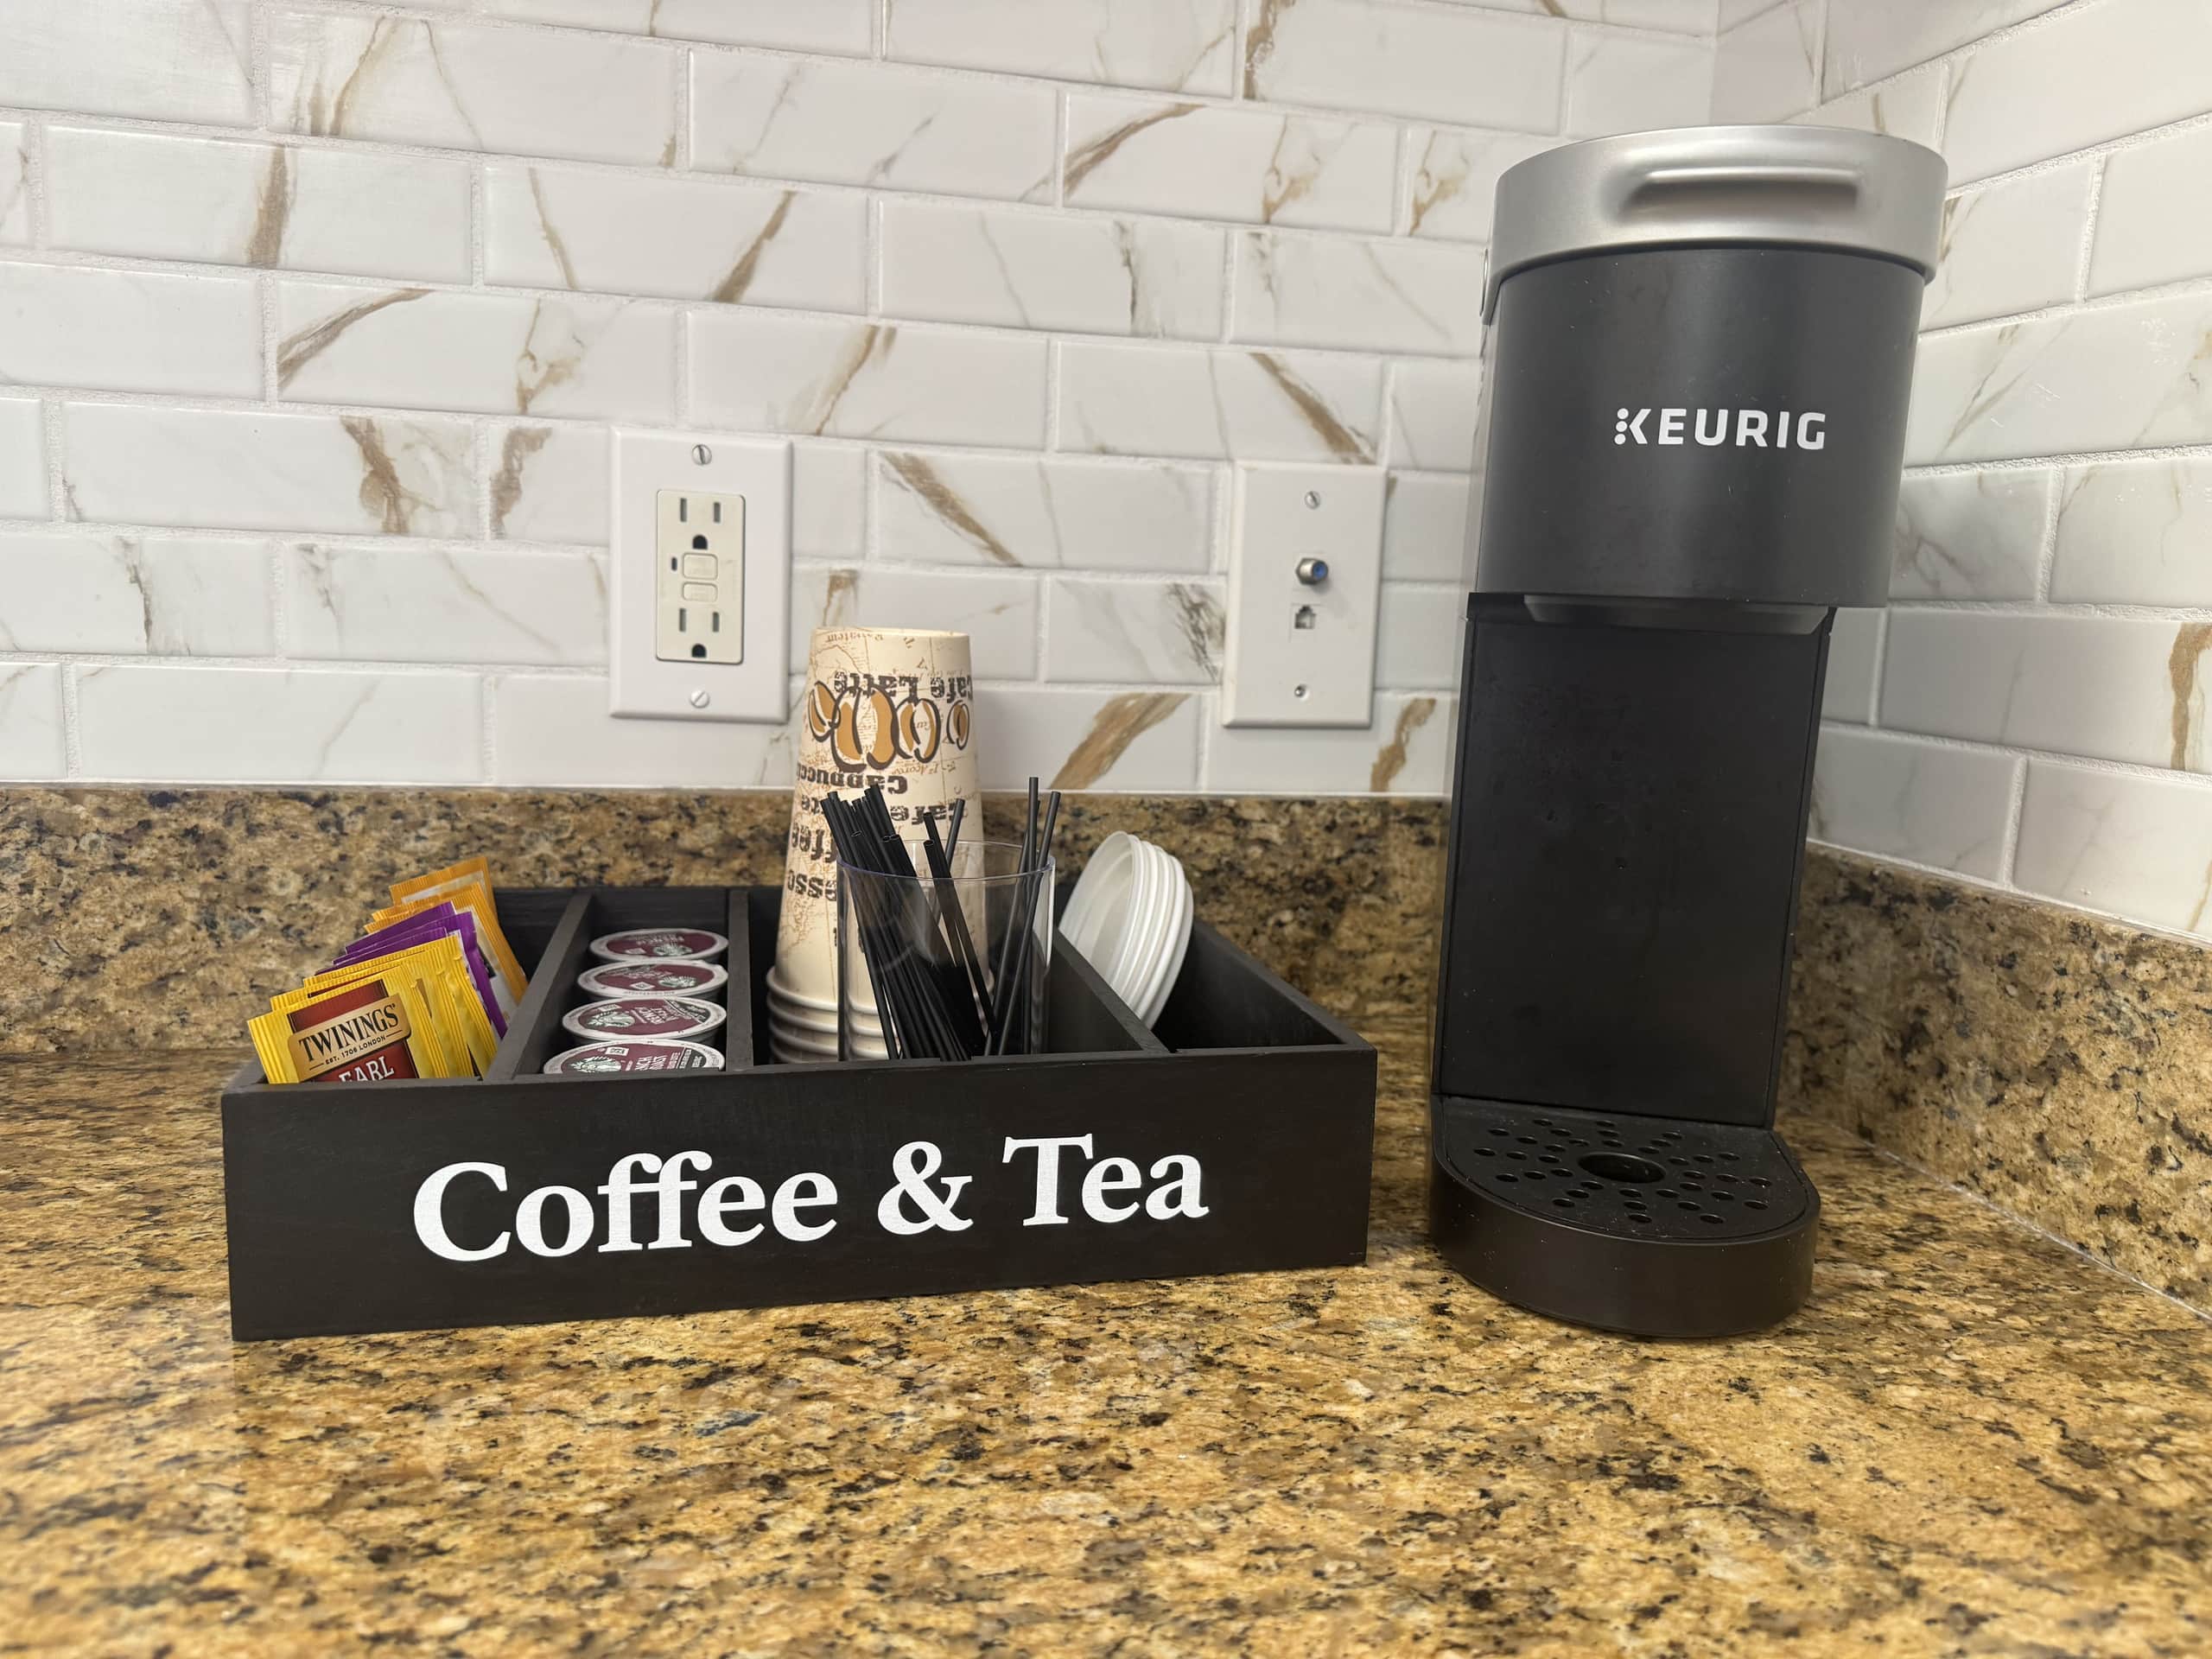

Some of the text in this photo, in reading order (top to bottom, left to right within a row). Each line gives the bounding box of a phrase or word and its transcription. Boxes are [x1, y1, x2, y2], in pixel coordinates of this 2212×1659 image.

[1615, 408, 1825, 449] KEURIG
[833, 671, 974, 706] Cafe Latte
[325, 1034, 386, 1065] EST. 1706 LONDON
[414, 1134, 1209, 1261] Coffee & Tea
